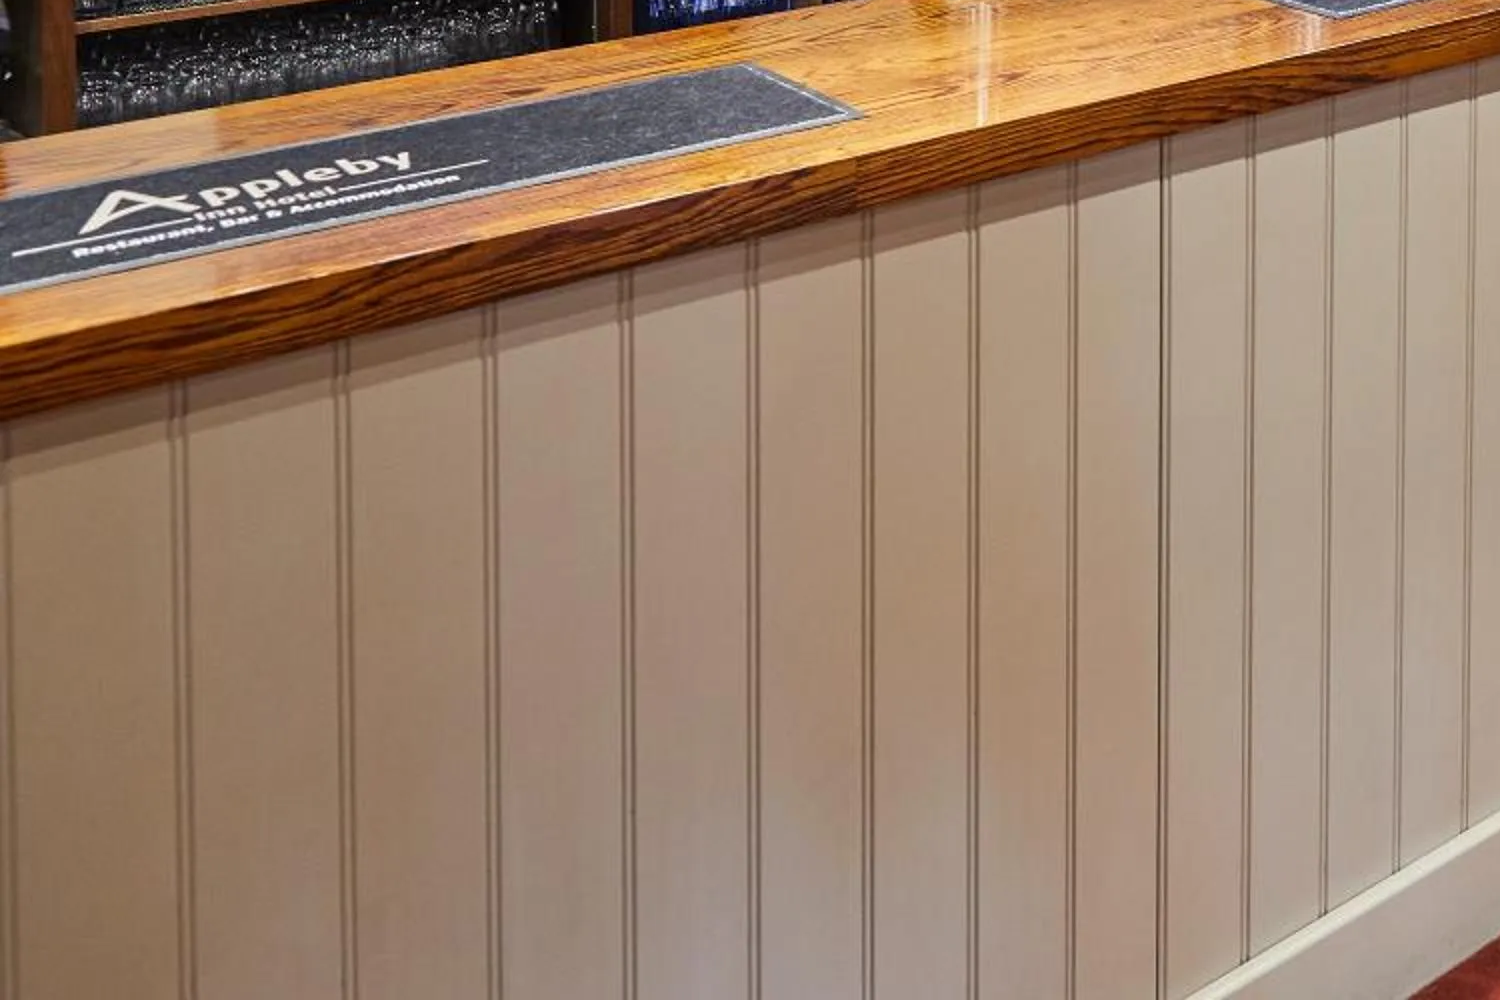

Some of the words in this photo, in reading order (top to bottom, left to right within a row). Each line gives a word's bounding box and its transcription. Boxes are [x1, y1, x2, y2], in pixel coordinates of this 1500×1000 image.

[72, 225, 215, 258] Restaurant,
[219, 214, 259, 228] Bar
[290, 174, 462, 214] Accommodation
[79, 152, 411, 235] Appleby
[193, 206, 247, 222] Inn
[253, 186, 337, 211] Hotel
